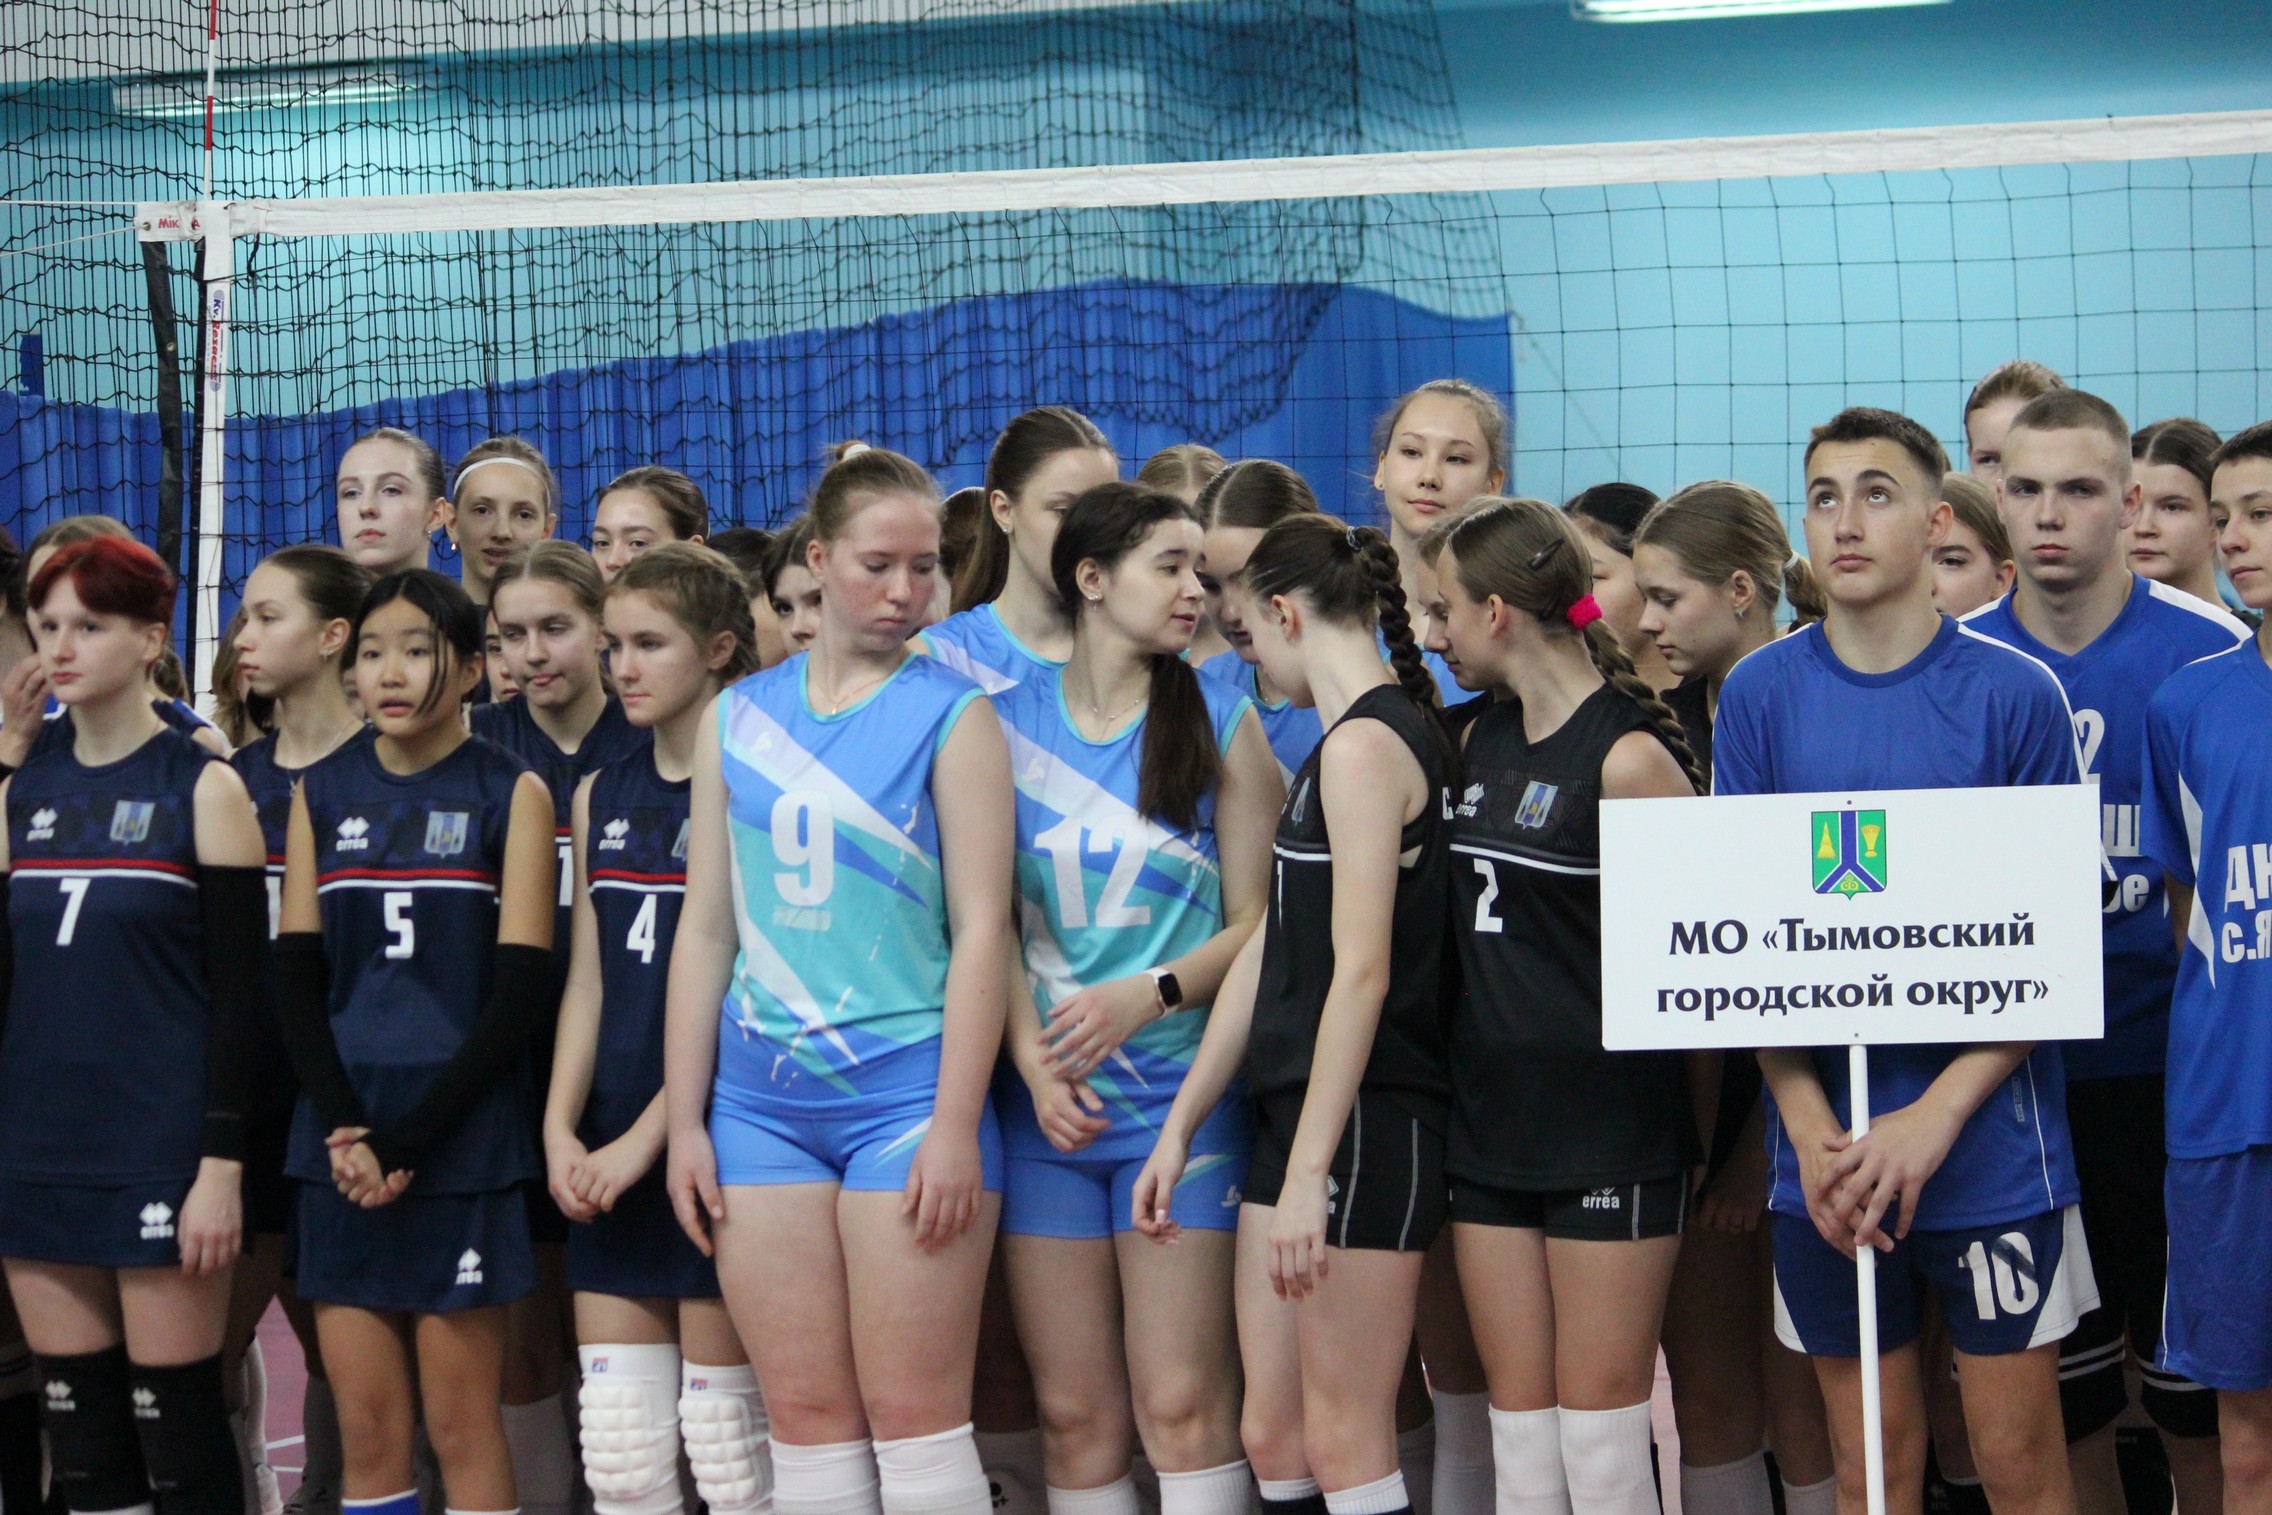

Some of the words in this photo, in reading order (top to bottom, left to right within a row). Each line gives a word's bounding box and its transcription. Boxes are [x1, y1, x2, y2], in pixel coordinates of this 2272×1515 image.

[770, 788, 834, 907] 9
[1034, 812, 1151, 929] 12
[55, 877, 91, 946] 7
[383, 891, 415, 960] 5
[626, 893, 657, 964] 4
[1473, 858, 1503, 933] 2
[1669, 918, 1749, 955] МО
[1762, 912, 2035, 953] «Тымовский
[1656, 973, 1894, 1022] городской
[1906, 978, 2050, 1015] округ»
[1958, 1231, 2040, 1321] 10
